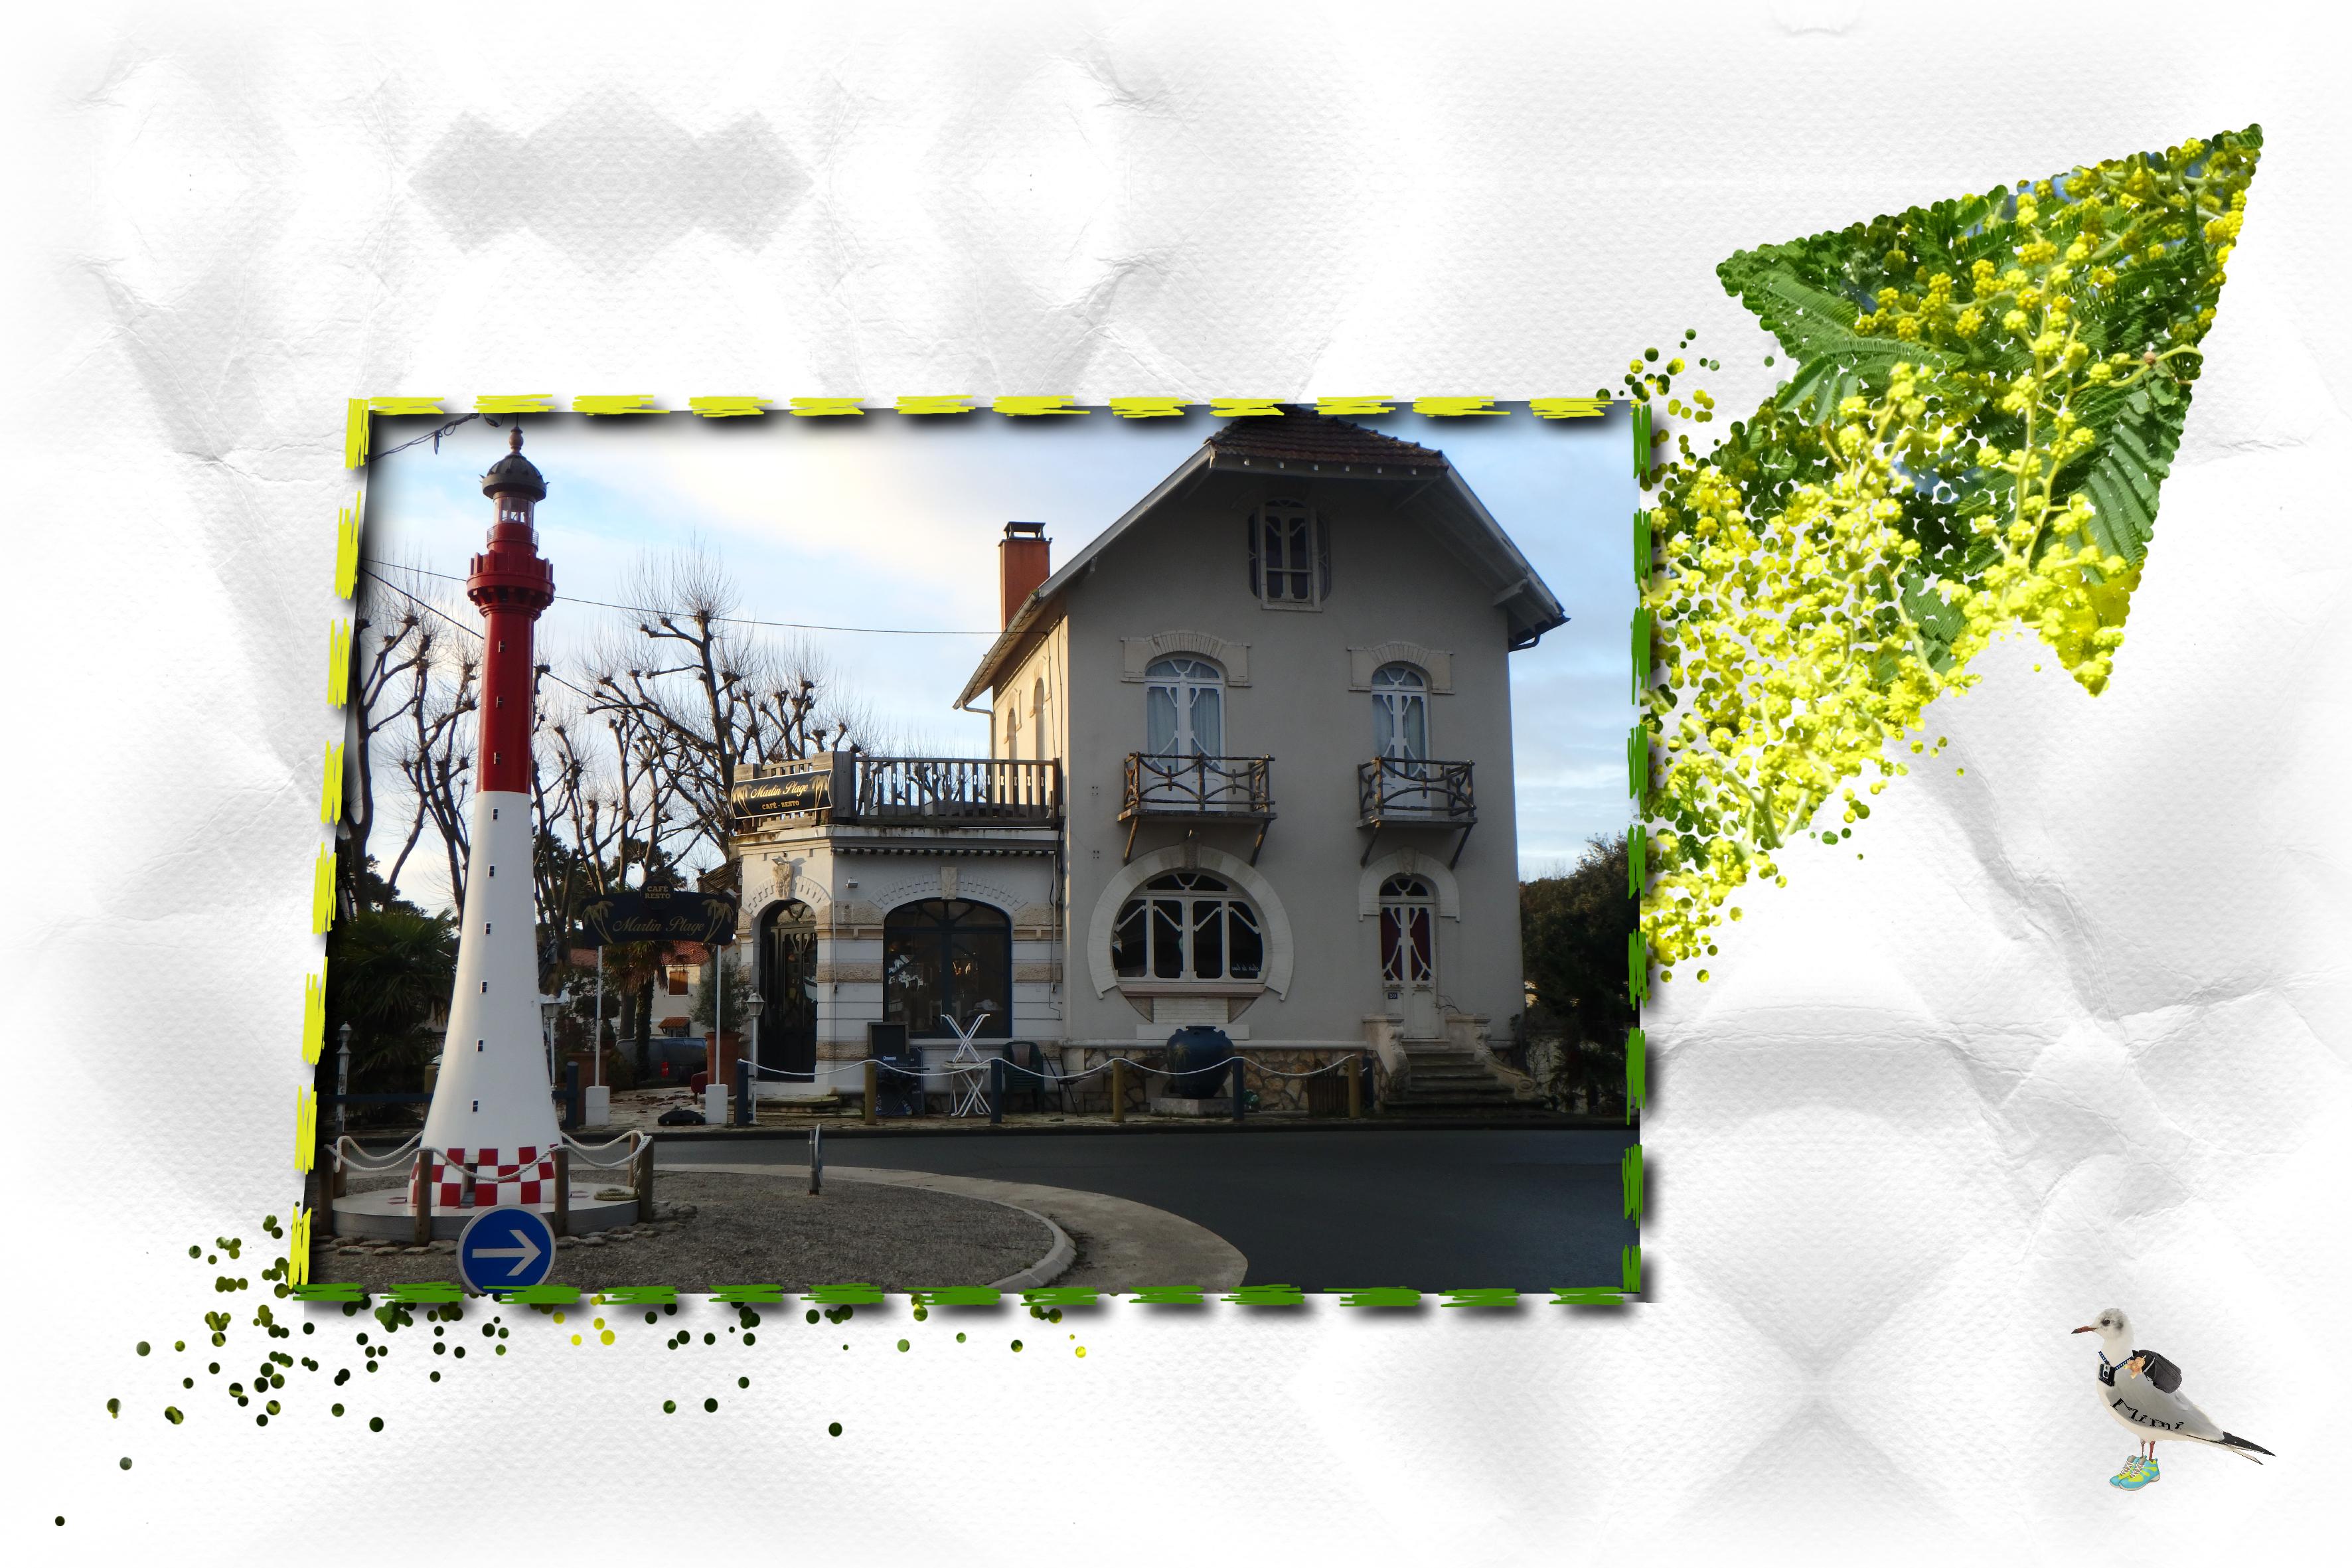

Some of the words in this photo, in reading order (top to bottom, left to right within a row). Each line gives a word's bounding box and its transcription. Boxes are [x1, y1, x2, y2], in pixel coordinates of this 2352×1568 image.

[751, 784, 781, 799] Martin
[783, 781, 809, 797] Plage
[762, 801, 777, 810] CAFÉ
[613, 916, 663, 932] Martin
[665, 915, 705, 935] Plage
